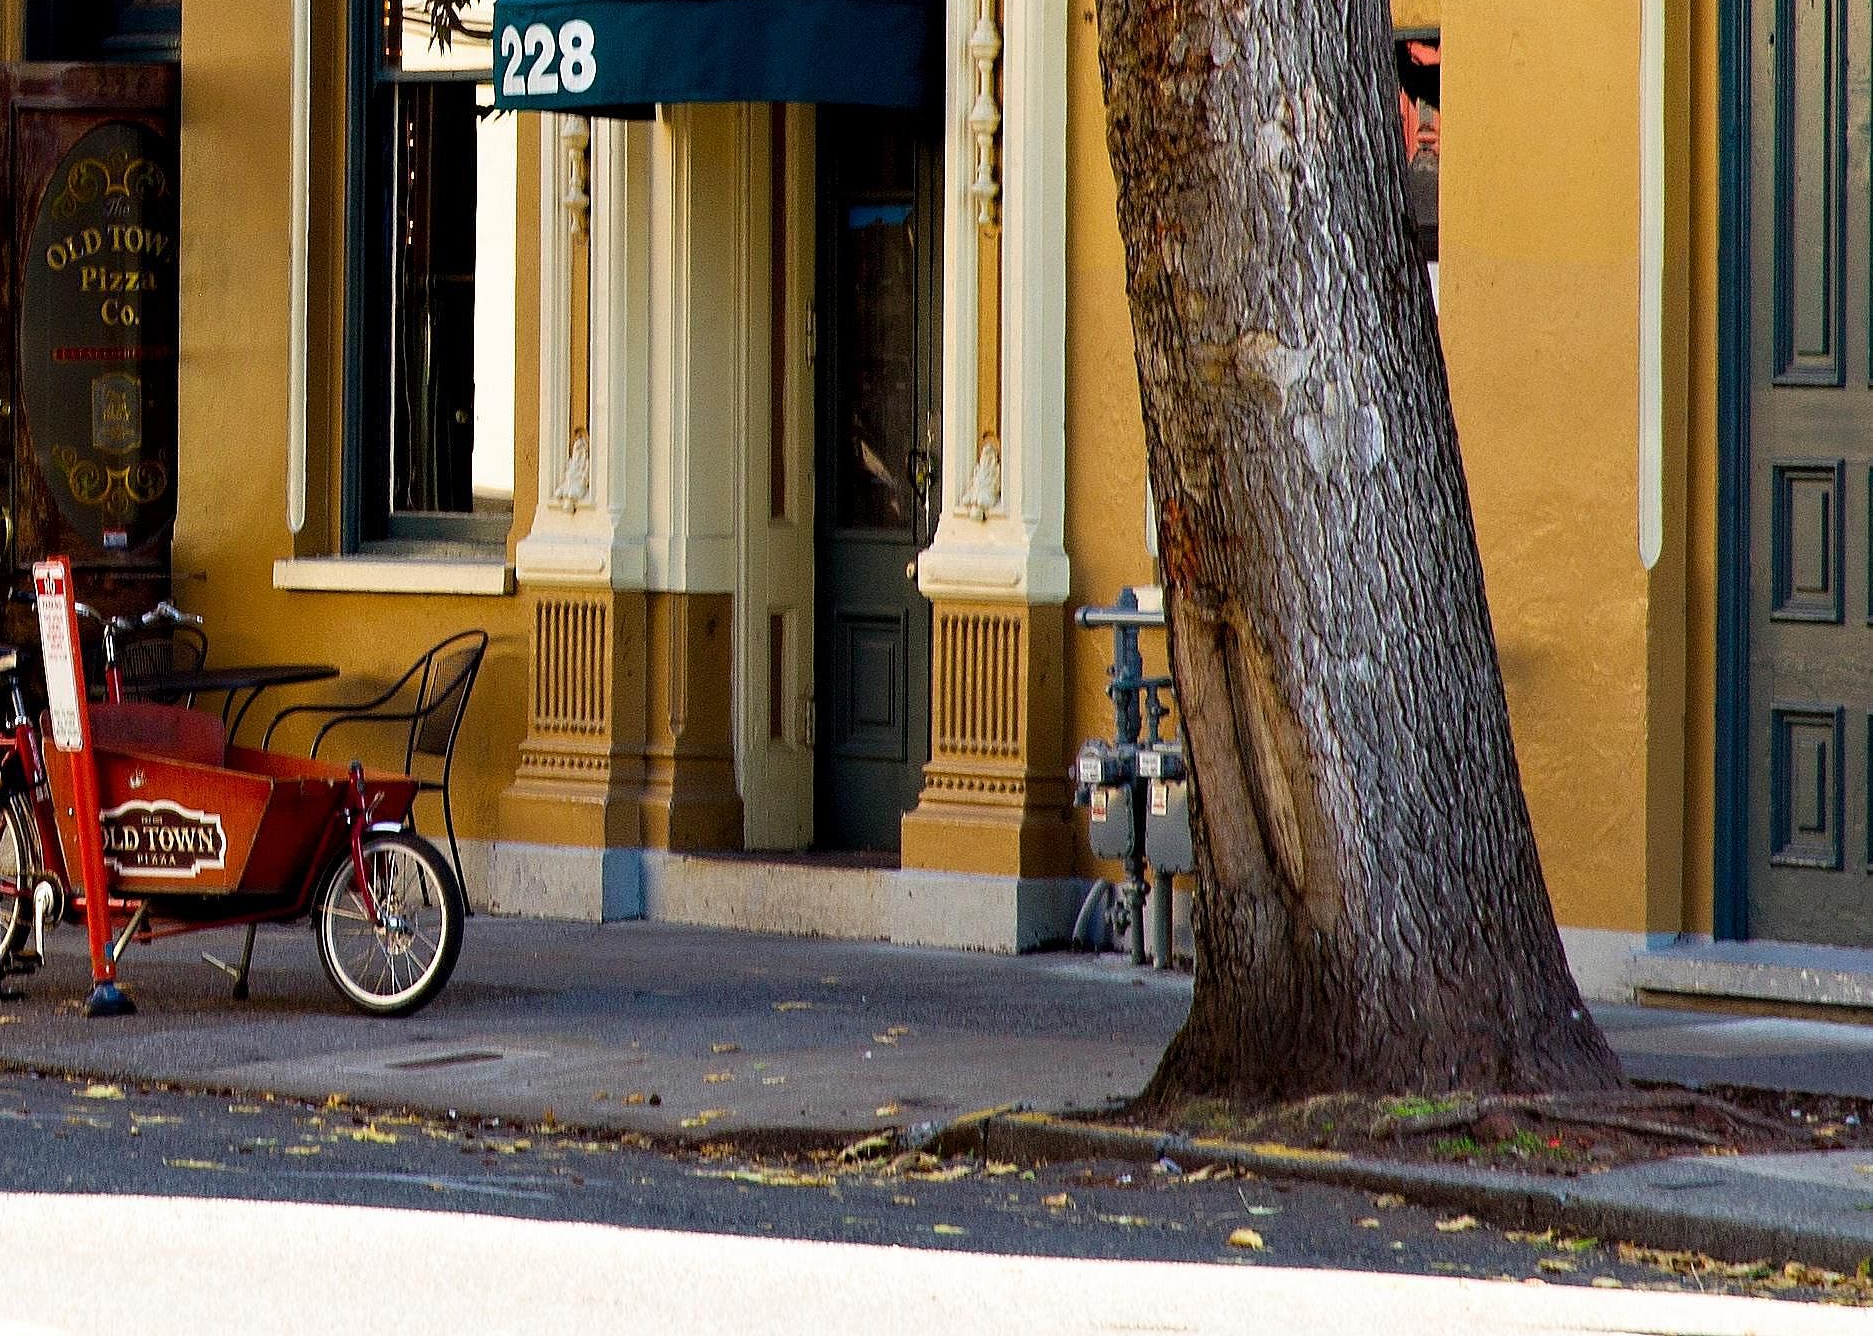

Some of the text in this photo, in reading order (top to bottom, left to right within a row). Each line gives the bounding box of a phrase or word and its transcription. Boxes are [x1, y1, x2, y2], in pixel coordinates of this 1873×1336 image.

[500, 18, 597, 97] 228
[46, 224, 172, 272] OLD TOW
[79, 266, 158, 294] Pizza
[100, 298, 141, 328] Co.
[142, 826, 215, 854] TOWN
